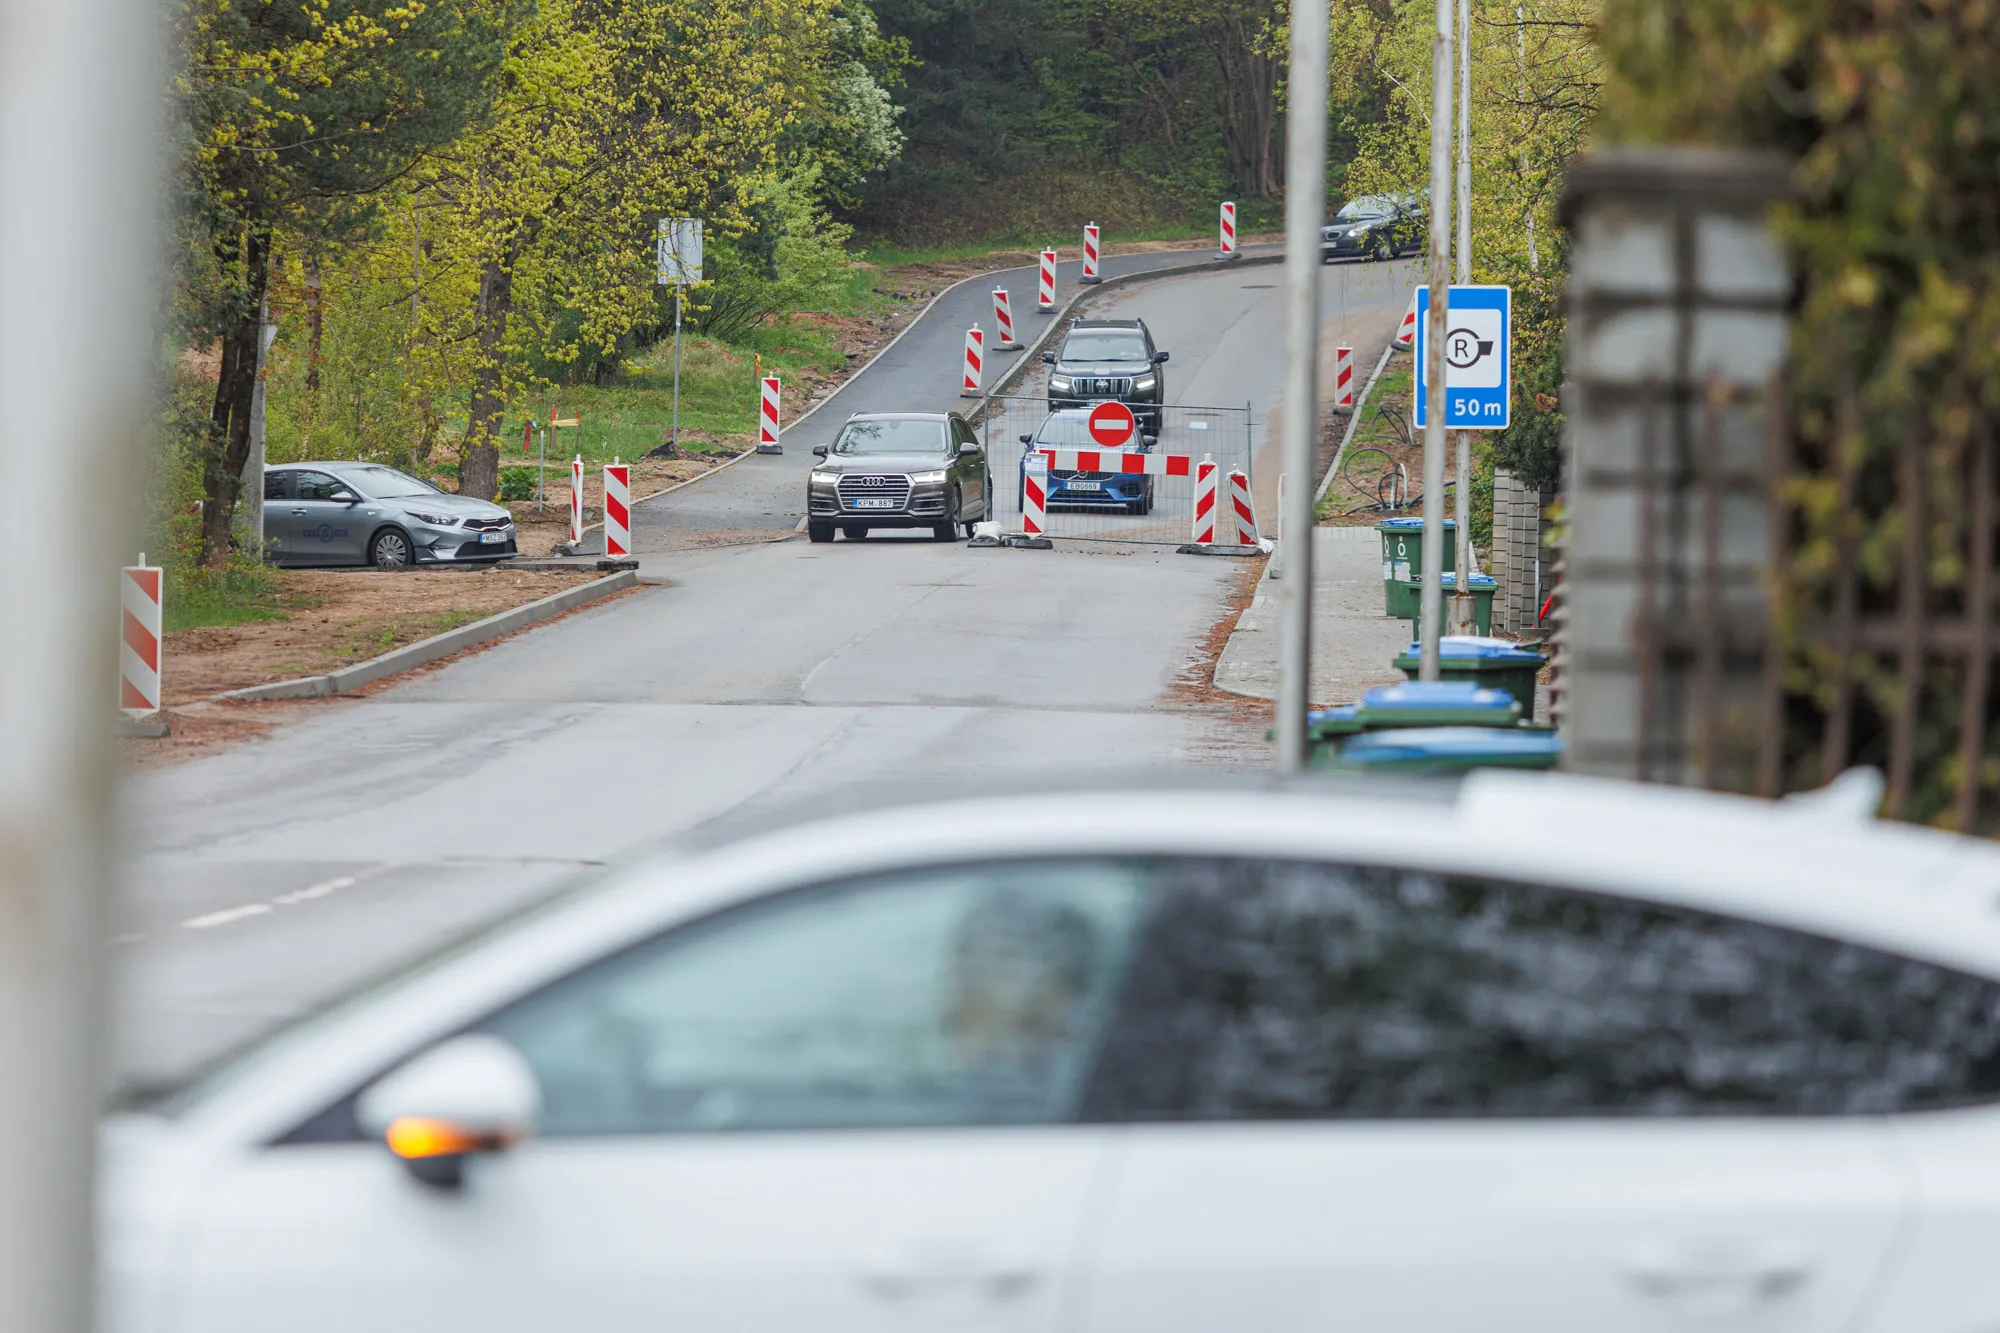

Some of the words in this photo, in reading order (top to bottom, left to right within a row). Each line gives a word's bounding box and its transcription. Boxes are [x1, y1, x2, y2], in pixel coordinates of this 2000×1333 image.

[1455, 338, 1468, 358] R
[1454, 398, 1479, 416] 50
[1484, 402, 1501, 416] m
